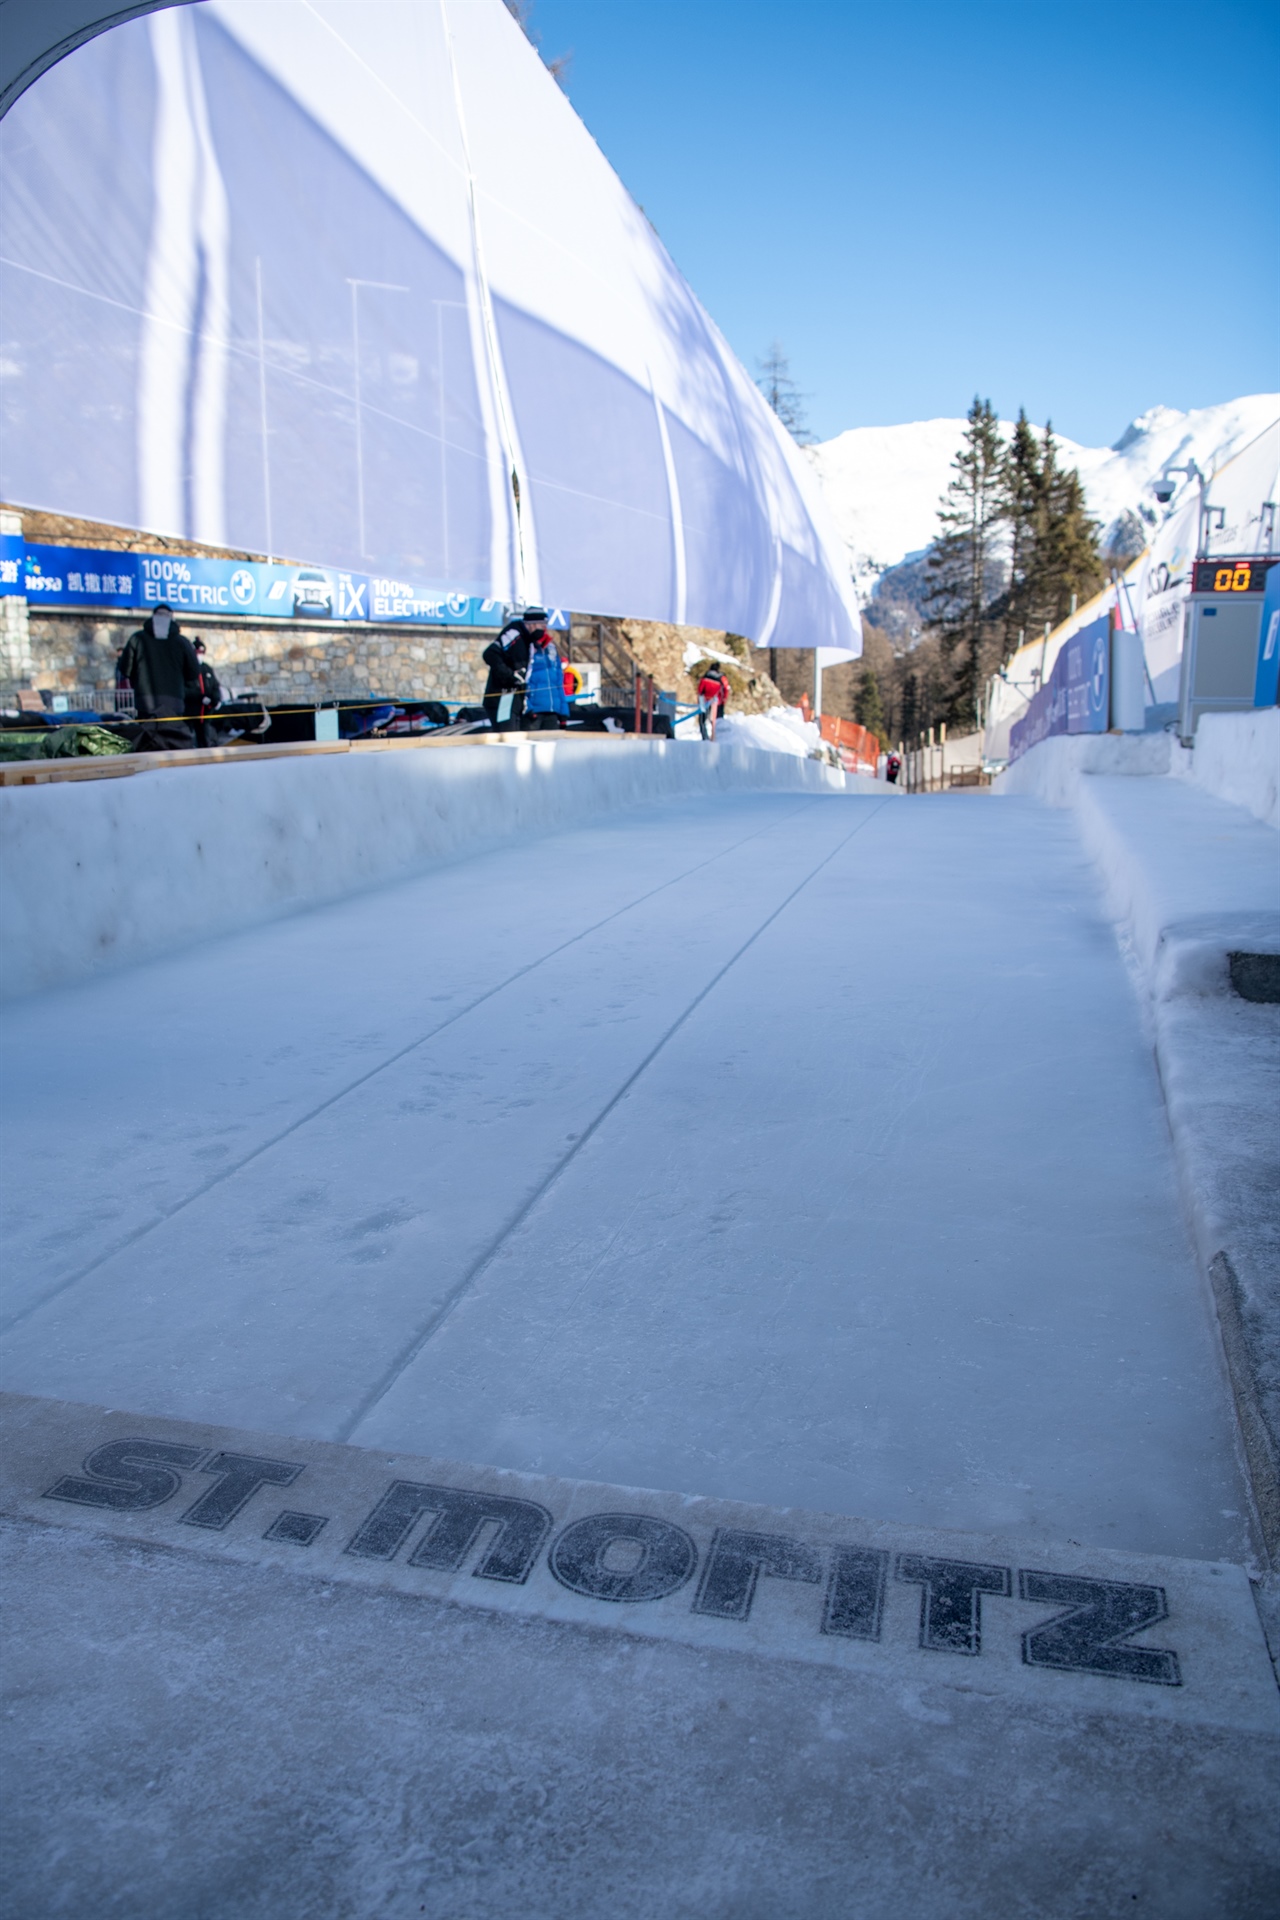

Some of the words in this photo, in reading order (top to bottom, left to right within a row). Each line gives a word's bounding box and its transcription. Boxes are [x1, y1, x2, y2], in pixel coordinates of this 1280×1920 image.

[142, 560, 191, 582] 100%
[144, 581, 229, 606] ELECTRIC
[372, 579, 414, 599] 100%
[374, 598, 445, 618] ELECTRIC
[41, 1437, 330, 1547] ST.
